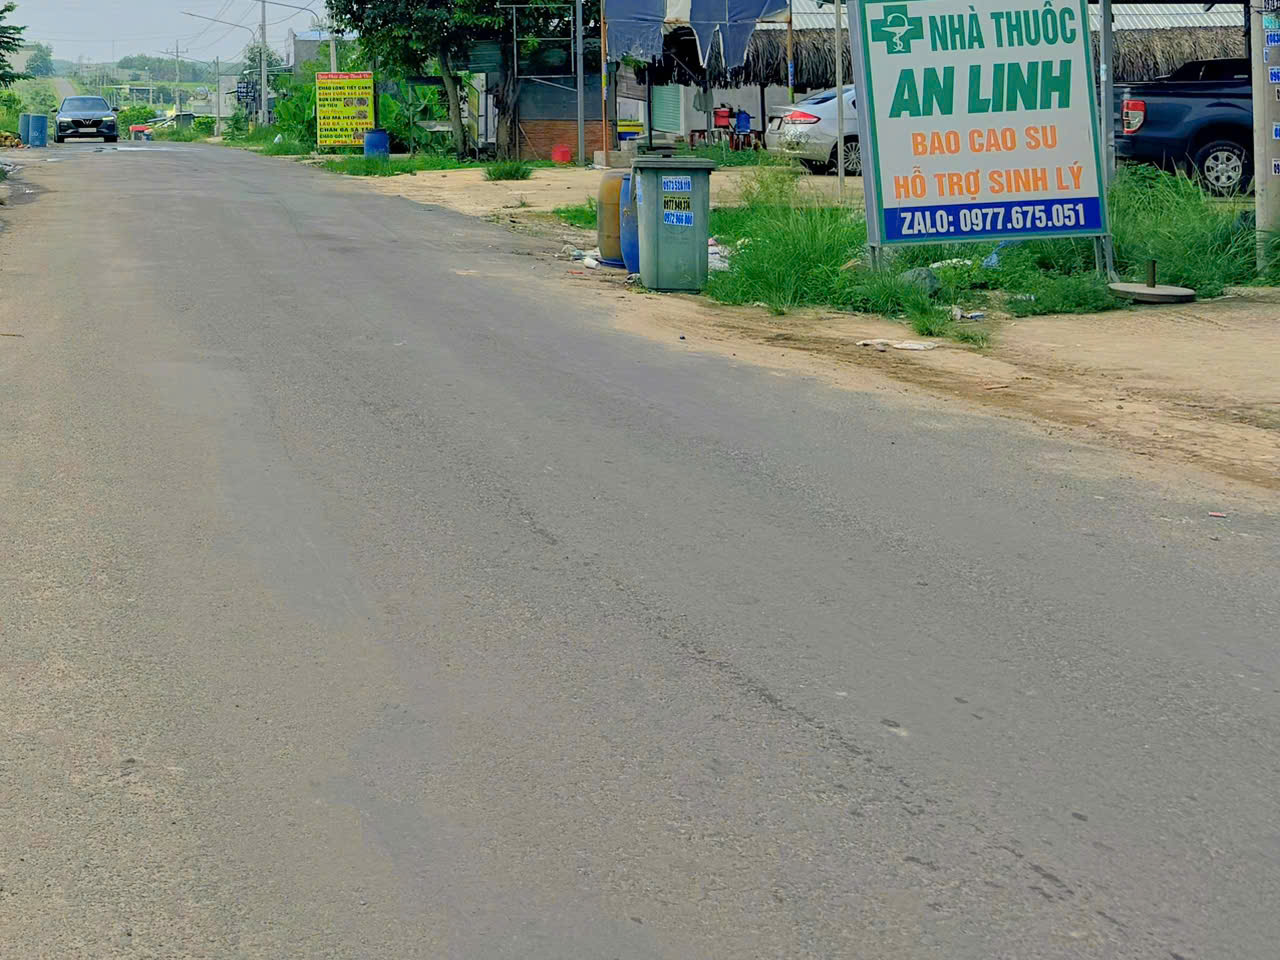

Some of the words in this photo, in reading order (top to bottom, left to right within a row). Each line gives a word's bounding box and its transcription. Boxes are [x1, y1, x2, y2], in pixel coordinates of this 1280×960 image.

[929, 5, 985, 52] NHÀ
[888, 66, 955, 118] AN
[968, 59, 1072, 114] LINH
[911, 130, 961, 156] BAO
[969, 127, 1017, 153] CAO
[1024, 125, 1058, 150] SU
[893, 165, 927, 200] HỖ
[933, 169, 980, 201] TRỢ
[989, 167, 1049, 194] SINH
[1056, 161, 1084, 190] LÝ
[901, 210, 955, 235] ZALO:
[959, 203, 1086, 231] 0977.675.051
